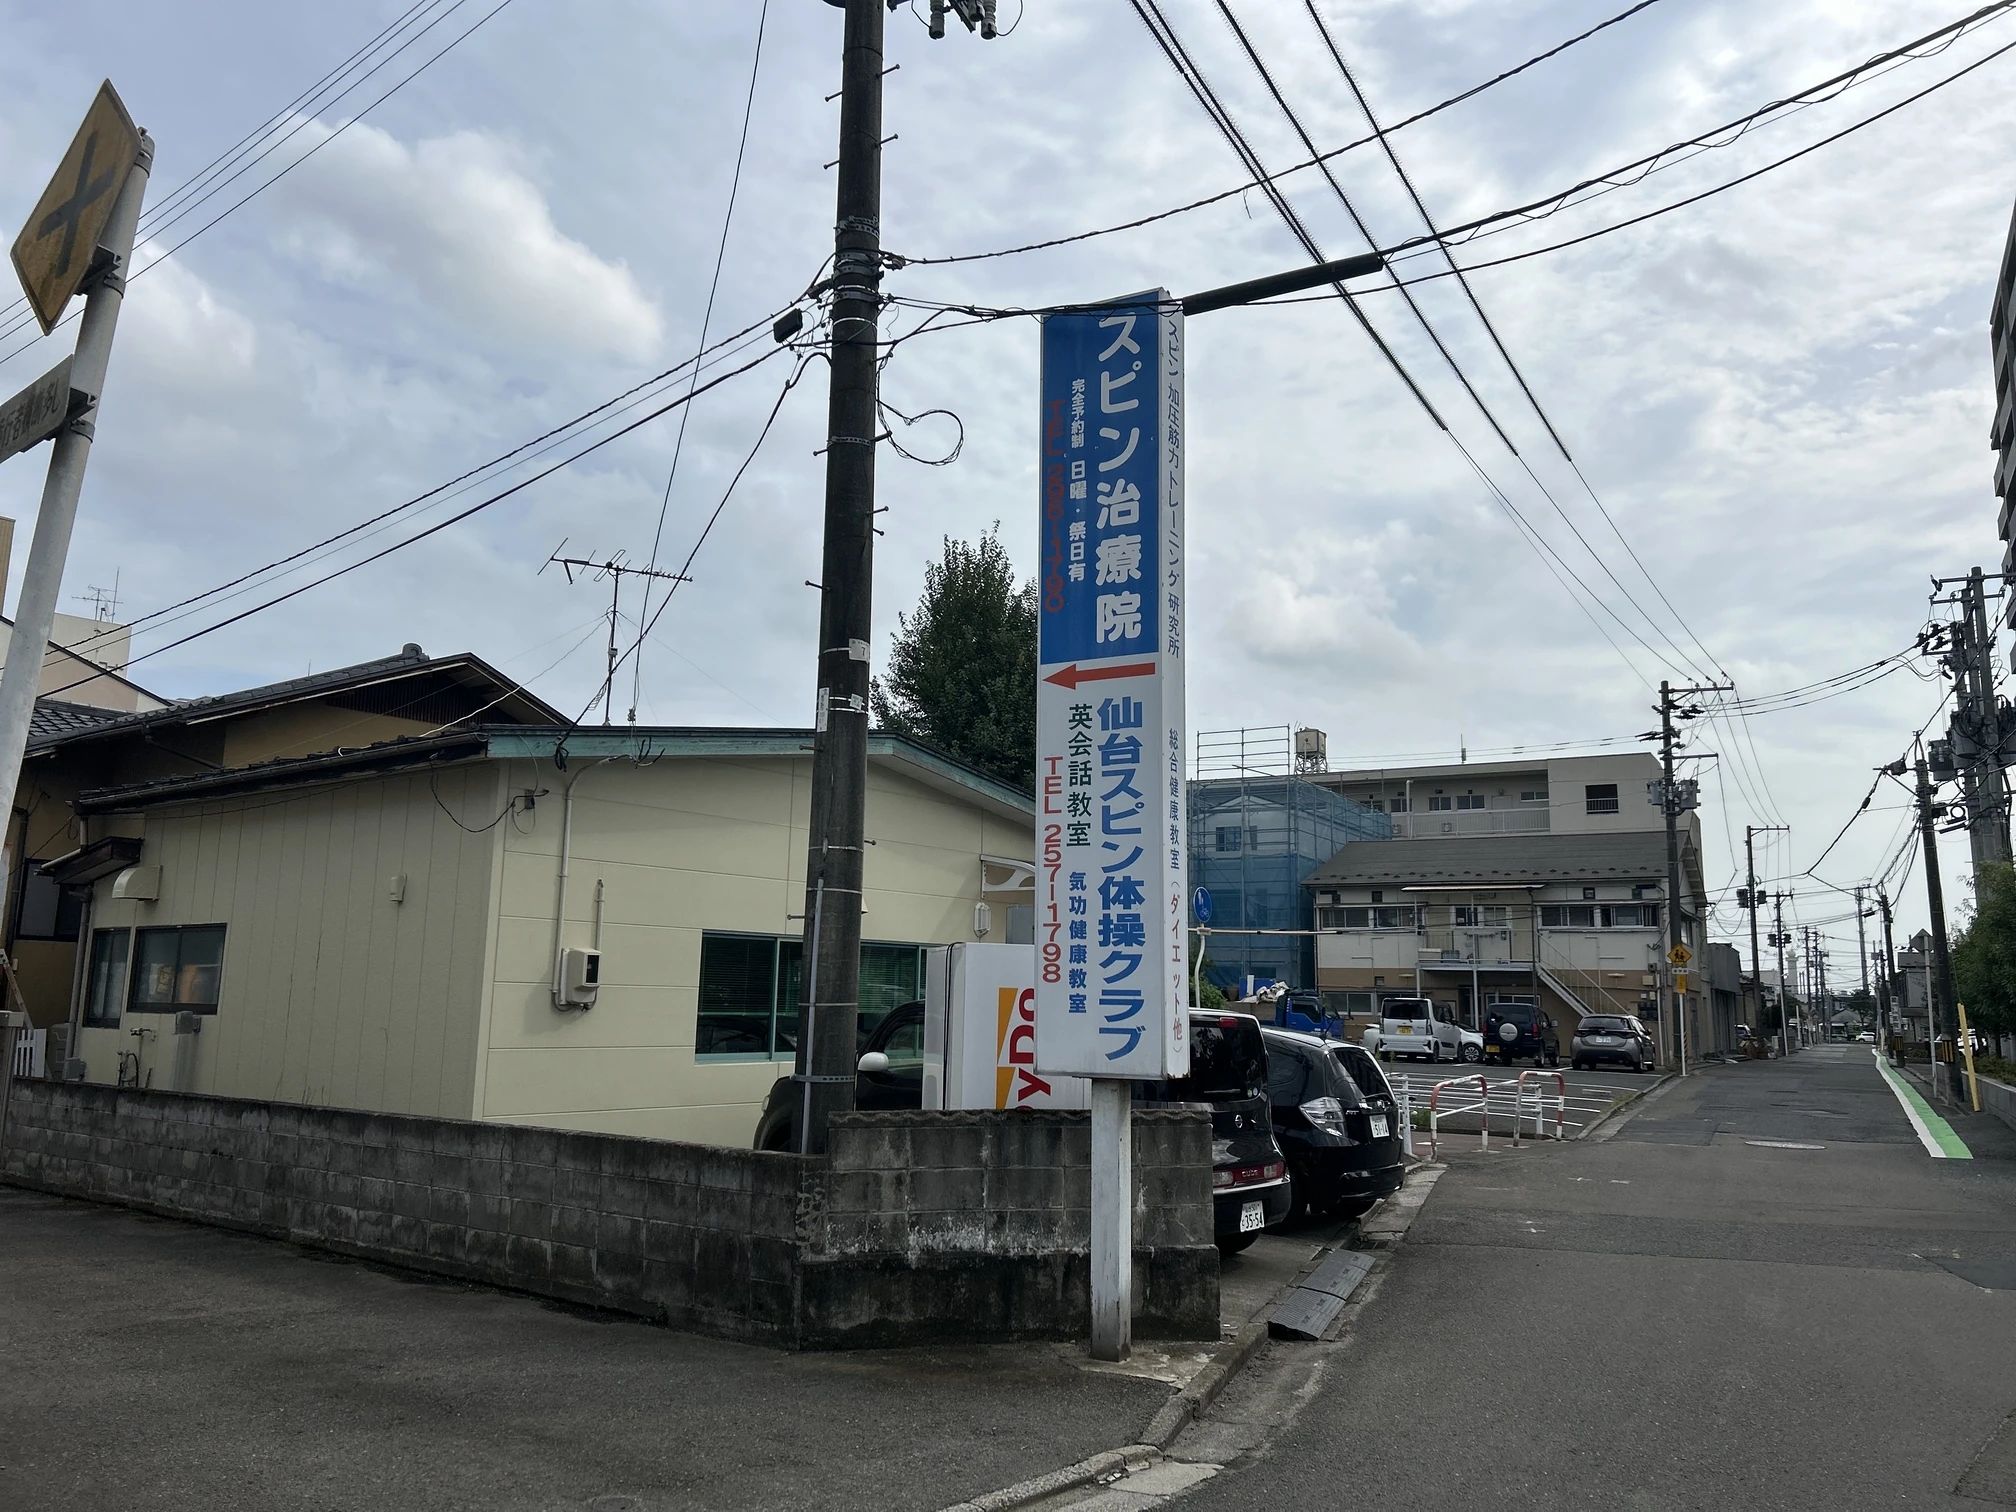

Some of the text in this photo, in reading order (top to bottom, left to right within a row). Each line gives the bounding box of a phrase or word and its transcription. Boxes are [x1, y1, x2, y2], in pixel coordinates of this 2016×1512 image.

[1071, 378, 1086, 449] 完全予約制
[1096, 312, 1142, 644] スピン治療院
[1066, 703, 1093, 847] 英会話教室
[1042, 756, 1063, 984] TEL 257-1798
[1069, 871, 1087, 1014] 気功健康教室
[1097, 696, 1146, 1061] 仙台スピン体操クラブ
